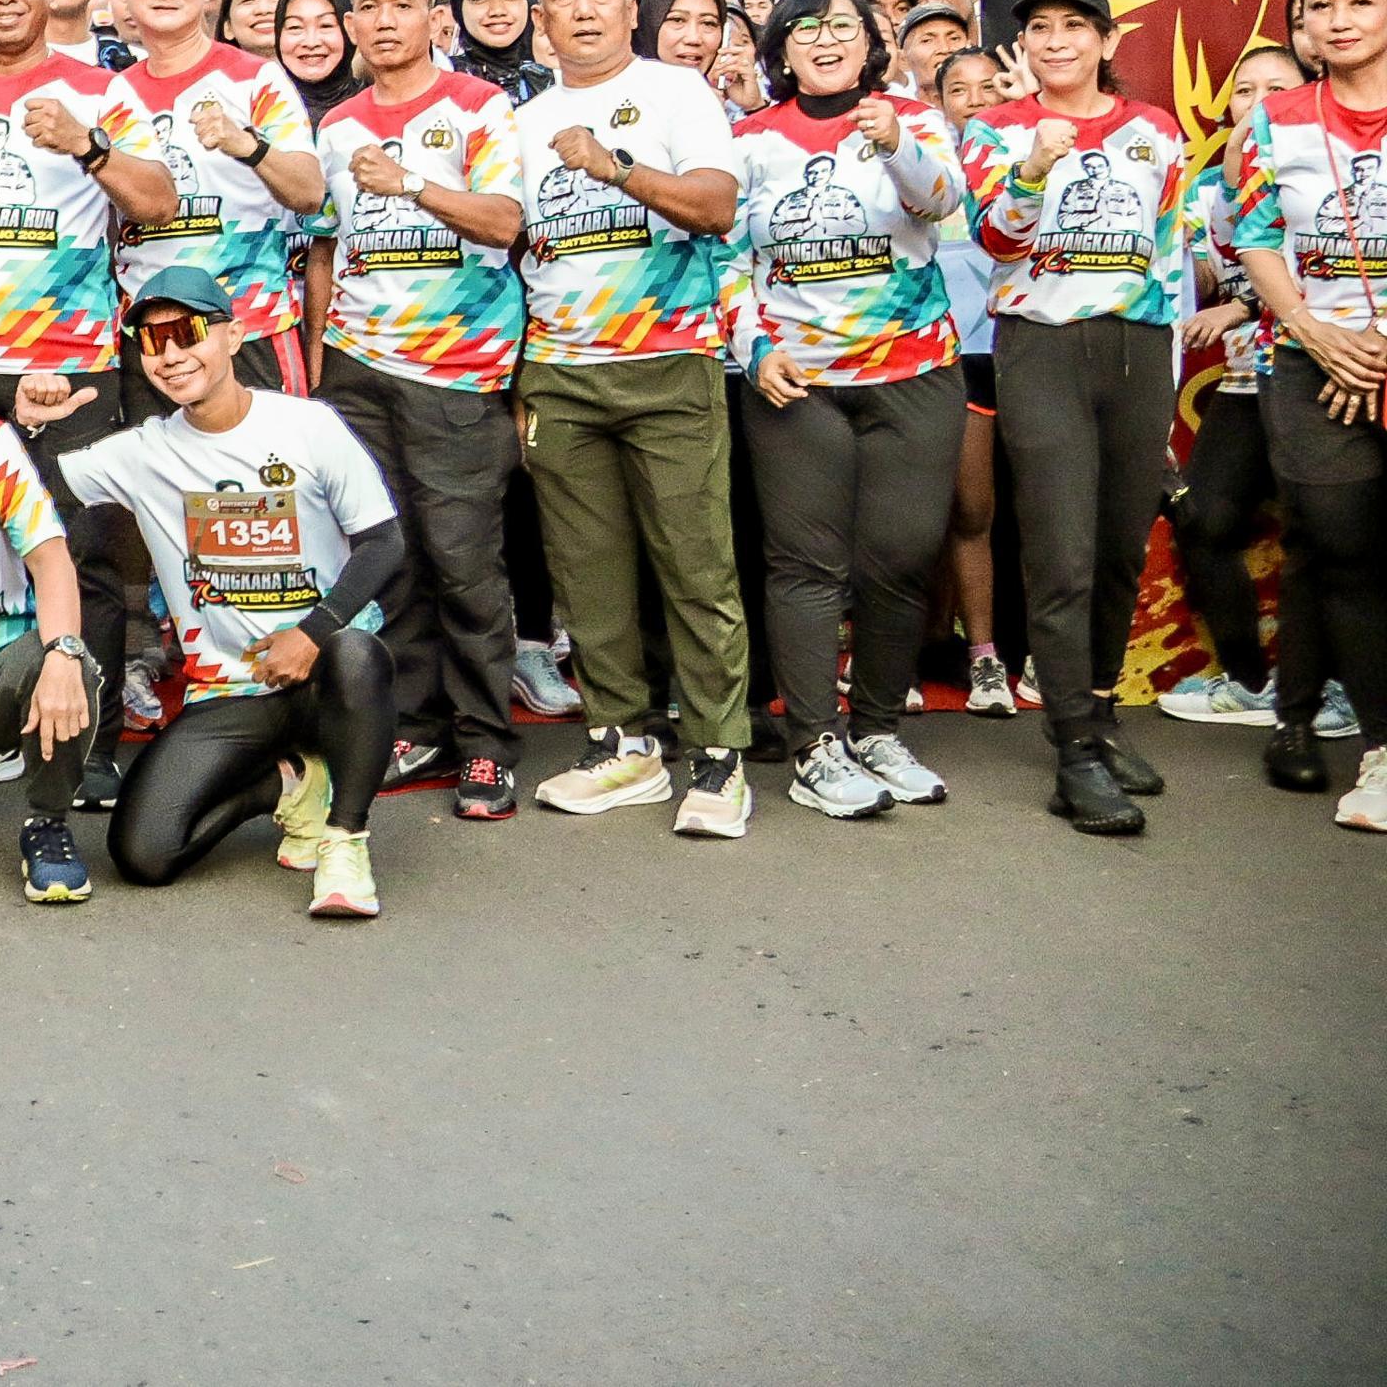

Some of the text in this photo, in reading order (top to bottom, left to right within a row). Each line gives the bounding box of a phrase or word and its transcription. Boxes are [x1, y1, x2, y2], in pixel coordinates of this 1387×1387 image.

[24, 209, 57, 229] RUN
[188, 218, 220, 229] 2024
[616, 206, 647, 226] RUN
[17, 231, 56, 241] 2024
[427, 228, 460, 249] RUN
[556, 230, 647, 249] JATENG 2024
[366, 251, 460, 263] JATENG 2024
[1071, 255, 1125, 265] JATENG
[793, 260, 851, 274] JATENG
[210, 518, 293, 546] 1354
